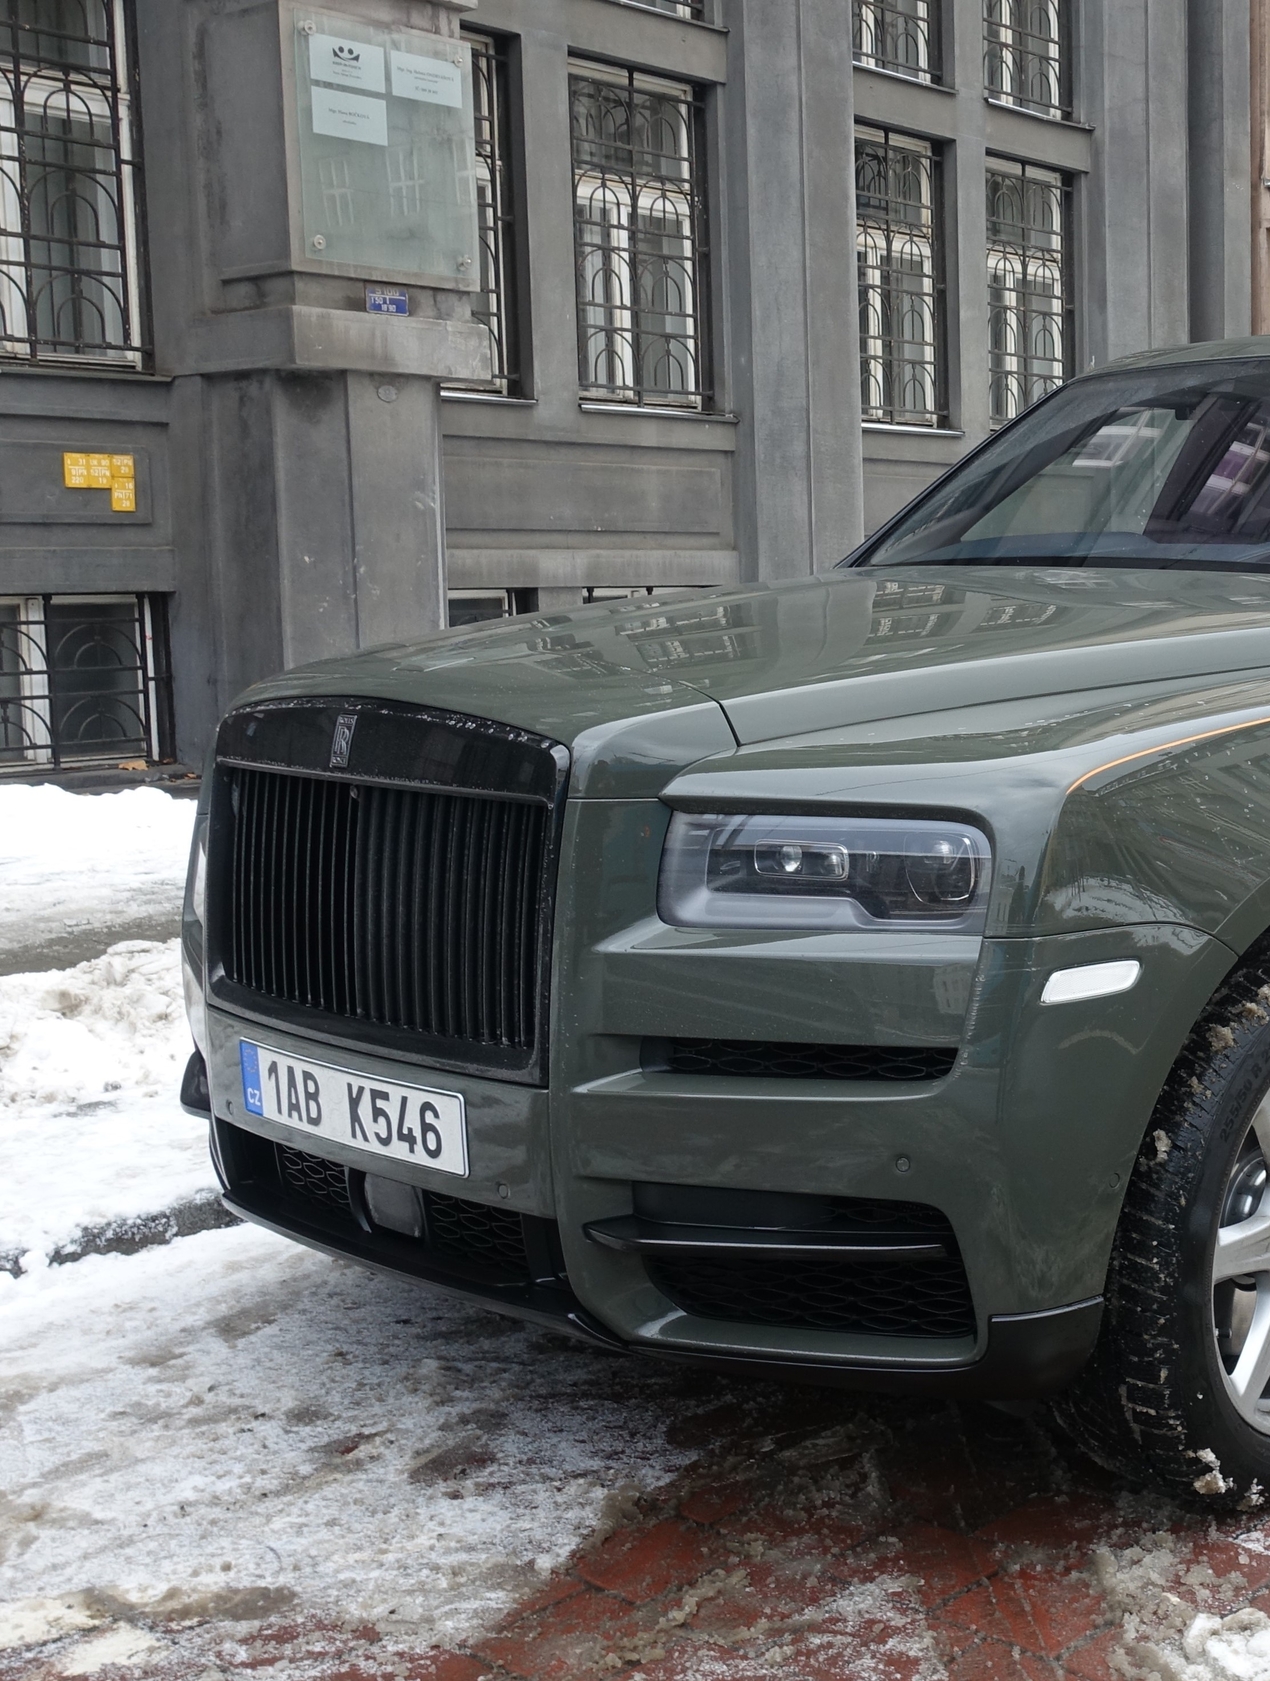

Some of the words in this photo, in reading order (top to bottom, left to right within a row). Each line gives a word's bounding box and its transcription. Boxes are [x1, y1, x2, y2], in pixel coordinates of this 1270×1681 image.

[247, 1086, 261, 1106] CZ
[267, 1059, 322, 1127] 1AB
[346, 1081, 443, 1160] K546
